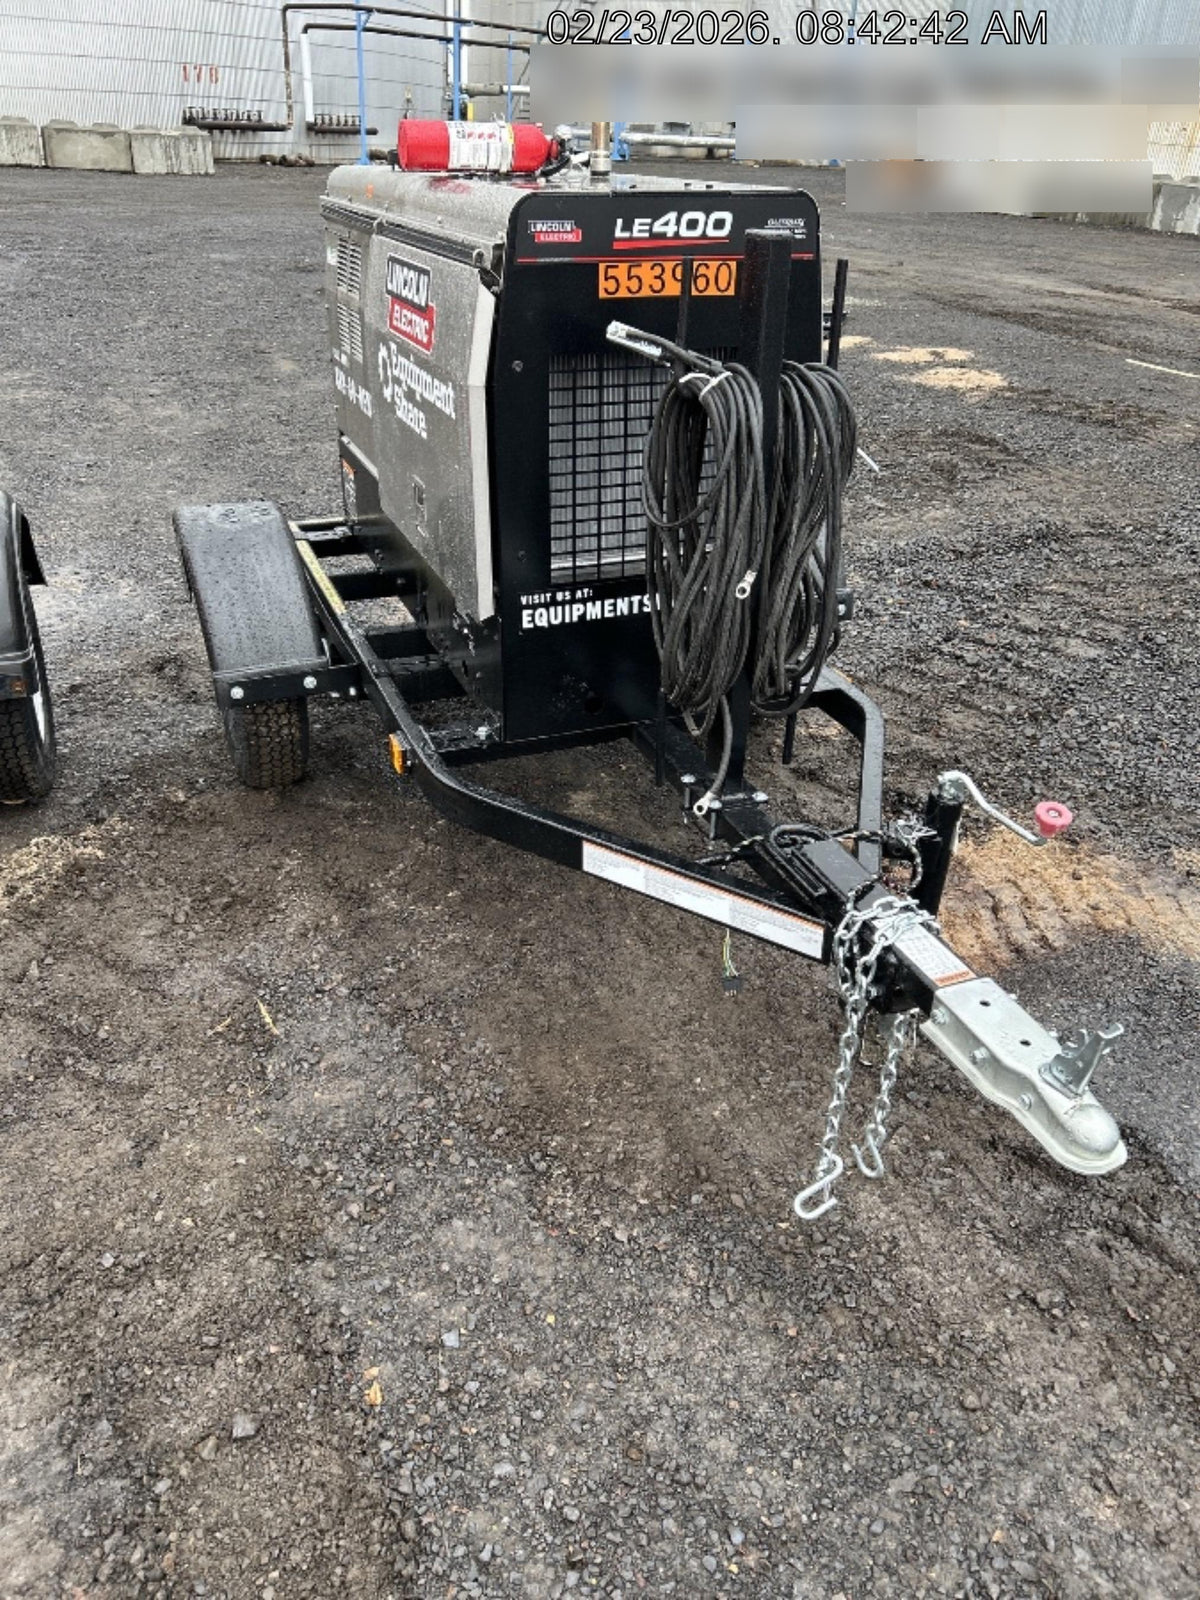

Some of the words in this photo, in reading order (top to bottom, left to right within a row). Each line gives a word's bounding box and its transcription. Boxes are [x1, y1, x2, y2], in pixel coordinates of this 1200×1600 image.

[530, 223, 572, 232] LINCOLN
[614, 211, 733, 238] LE400
[387, 260, 429, 307] LINCOLN
[603, 262, 732, 295] 553960
[392, 304, 430, 343] ELECTRIC
[389, 341, 456, 420] Equipment
[394, 384, 428, 440] Share
[520, 592, 552, 605] VISIT
[556, 590, 571, 602] US
[575, 588, 593, 599] AT:
[522, 593, 661, 629] EQUIPMENTS
